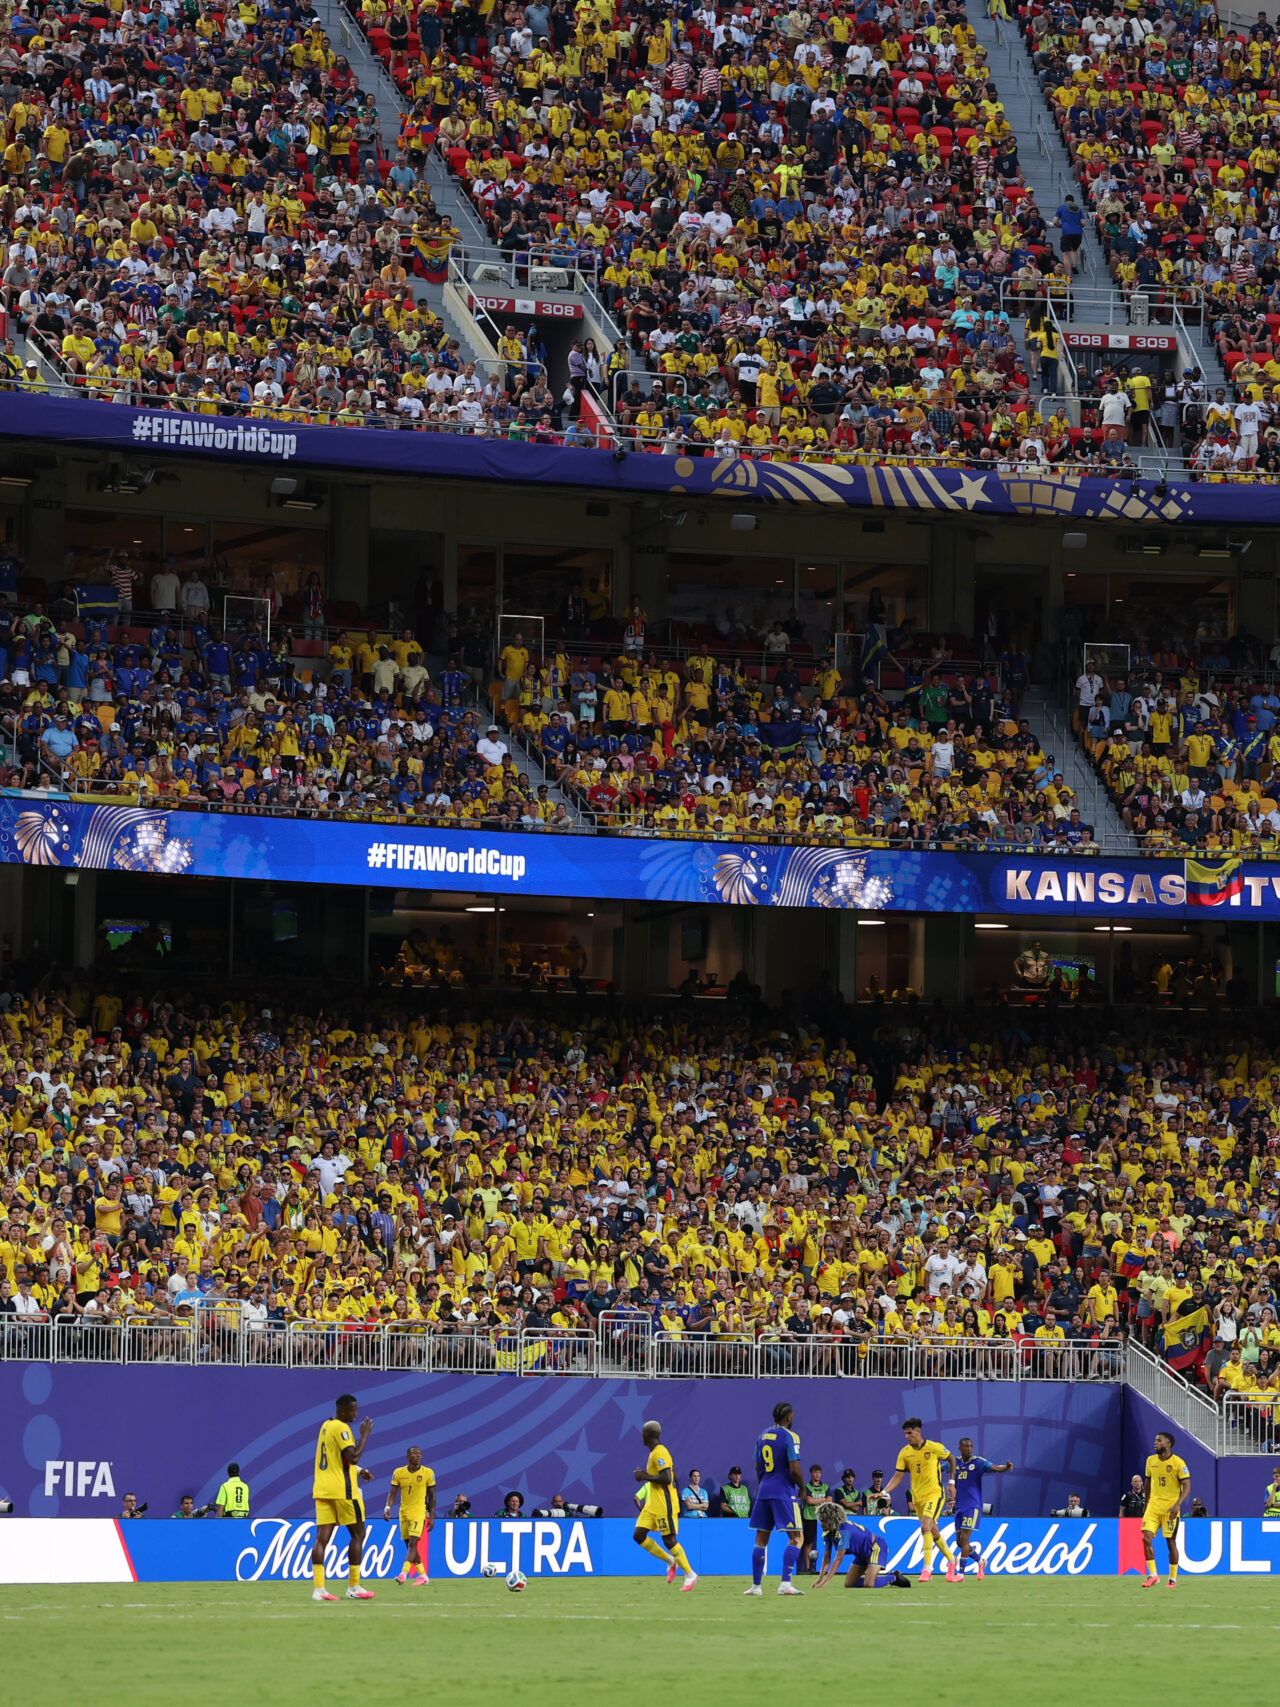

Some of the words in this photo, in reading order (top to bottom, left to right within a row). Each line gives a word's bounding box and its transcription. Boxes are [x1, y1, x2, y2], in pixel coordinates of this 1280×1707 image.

[476, 298, 508, 310] 307
[542, 304, 574, 316] 308
[1069, 334, 1102, 346] 308
[1136, 337, 1168, 348] 309
[132, 415, 297, 460] #FIFAWorldCup
[367, 843, 526, 880] #FIFAWorldCup
[1006, 869, 1186, 904] KANSAS
[319, 1442, 328, 1470] 6
[762, 1444, 774, 1472] 9
[916, 1464, 920, 1474] 3
[958, 1470, 968, 1480] 20
[44, 1460, 116, 1497] FIFA
[1158, 1476, 1166, 1487] 15
[927, 1502, 932, 1510] 3
[413, 1522, 418, 1530] 7
[658, 1518, 667, 1529] 13
[962, 1516, 972, 1526] 20
[1167, 1520, 1174, 1532] 15
[445, 1522, 594, 1574] ULTRA
